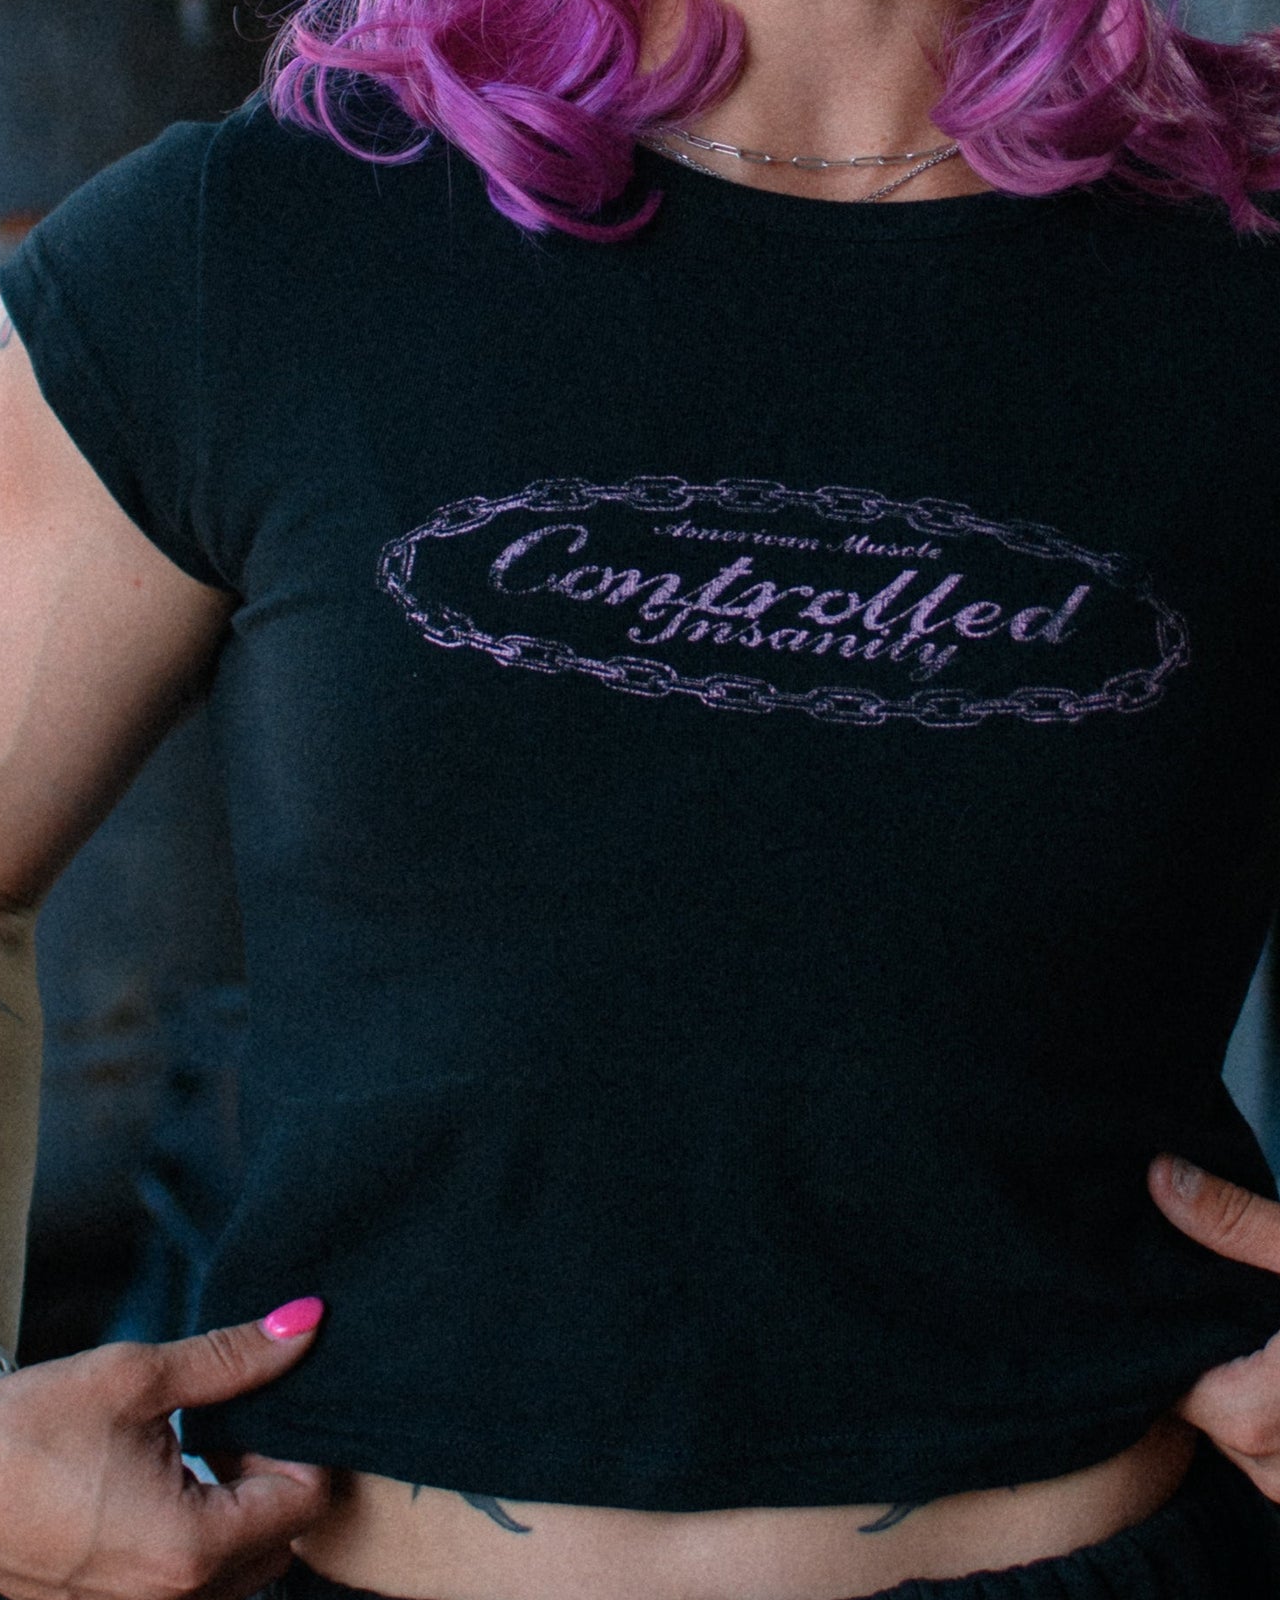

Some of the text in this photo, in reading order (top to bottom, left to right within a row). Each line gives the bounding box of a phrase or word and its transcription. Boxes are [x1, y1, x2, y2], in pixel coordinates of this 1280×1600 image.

[652, 519, 943, 561] American Muscle
[486, 522, 1091, 645] Controlled
[627, 602, 959, 682] Insanity
